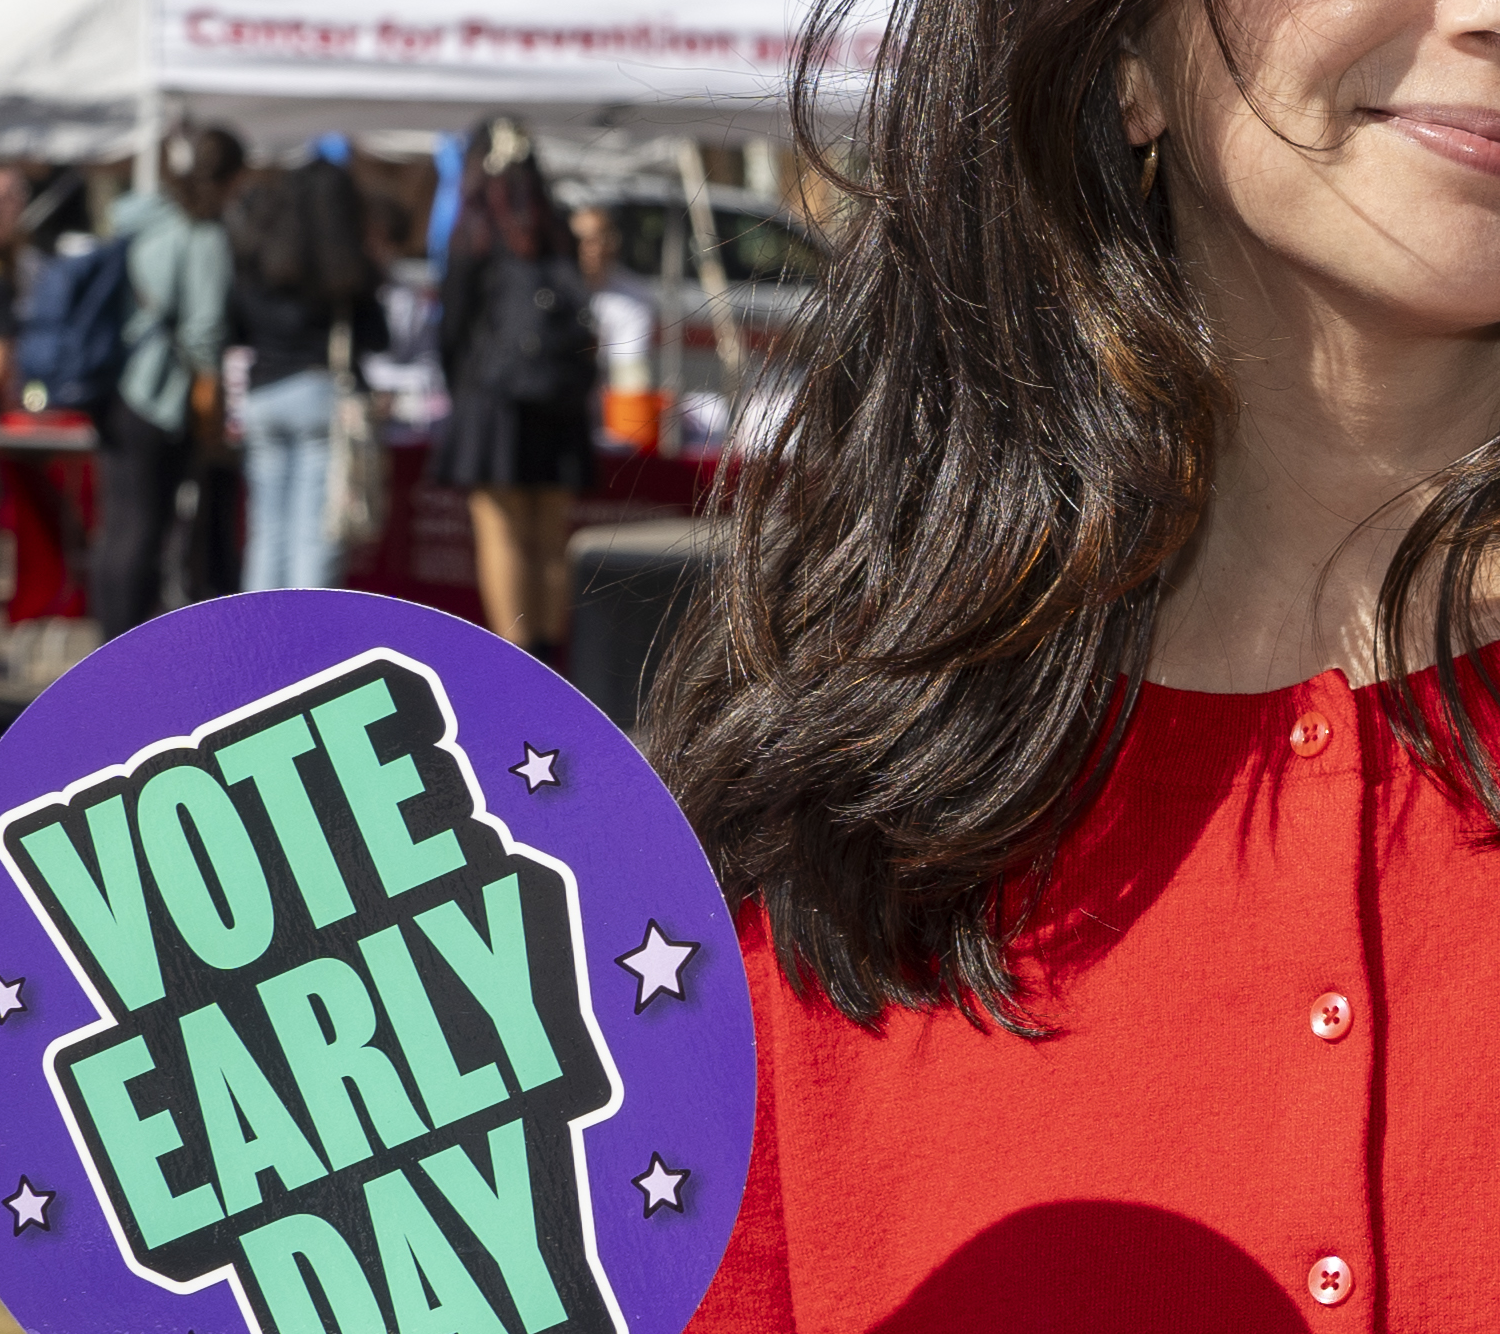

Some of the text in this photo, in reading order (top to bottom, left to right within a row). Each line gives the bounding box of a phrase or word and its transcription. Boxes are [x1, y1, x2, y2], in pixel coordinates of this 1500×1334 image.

[183, 5, 357, 57] Center
[374, 15, 444, 57] for
[458, 13, 738, 63] Prevention
[19, 677, 467, 1012] VOTE
[69, 872, 563, 1251] EARLY
